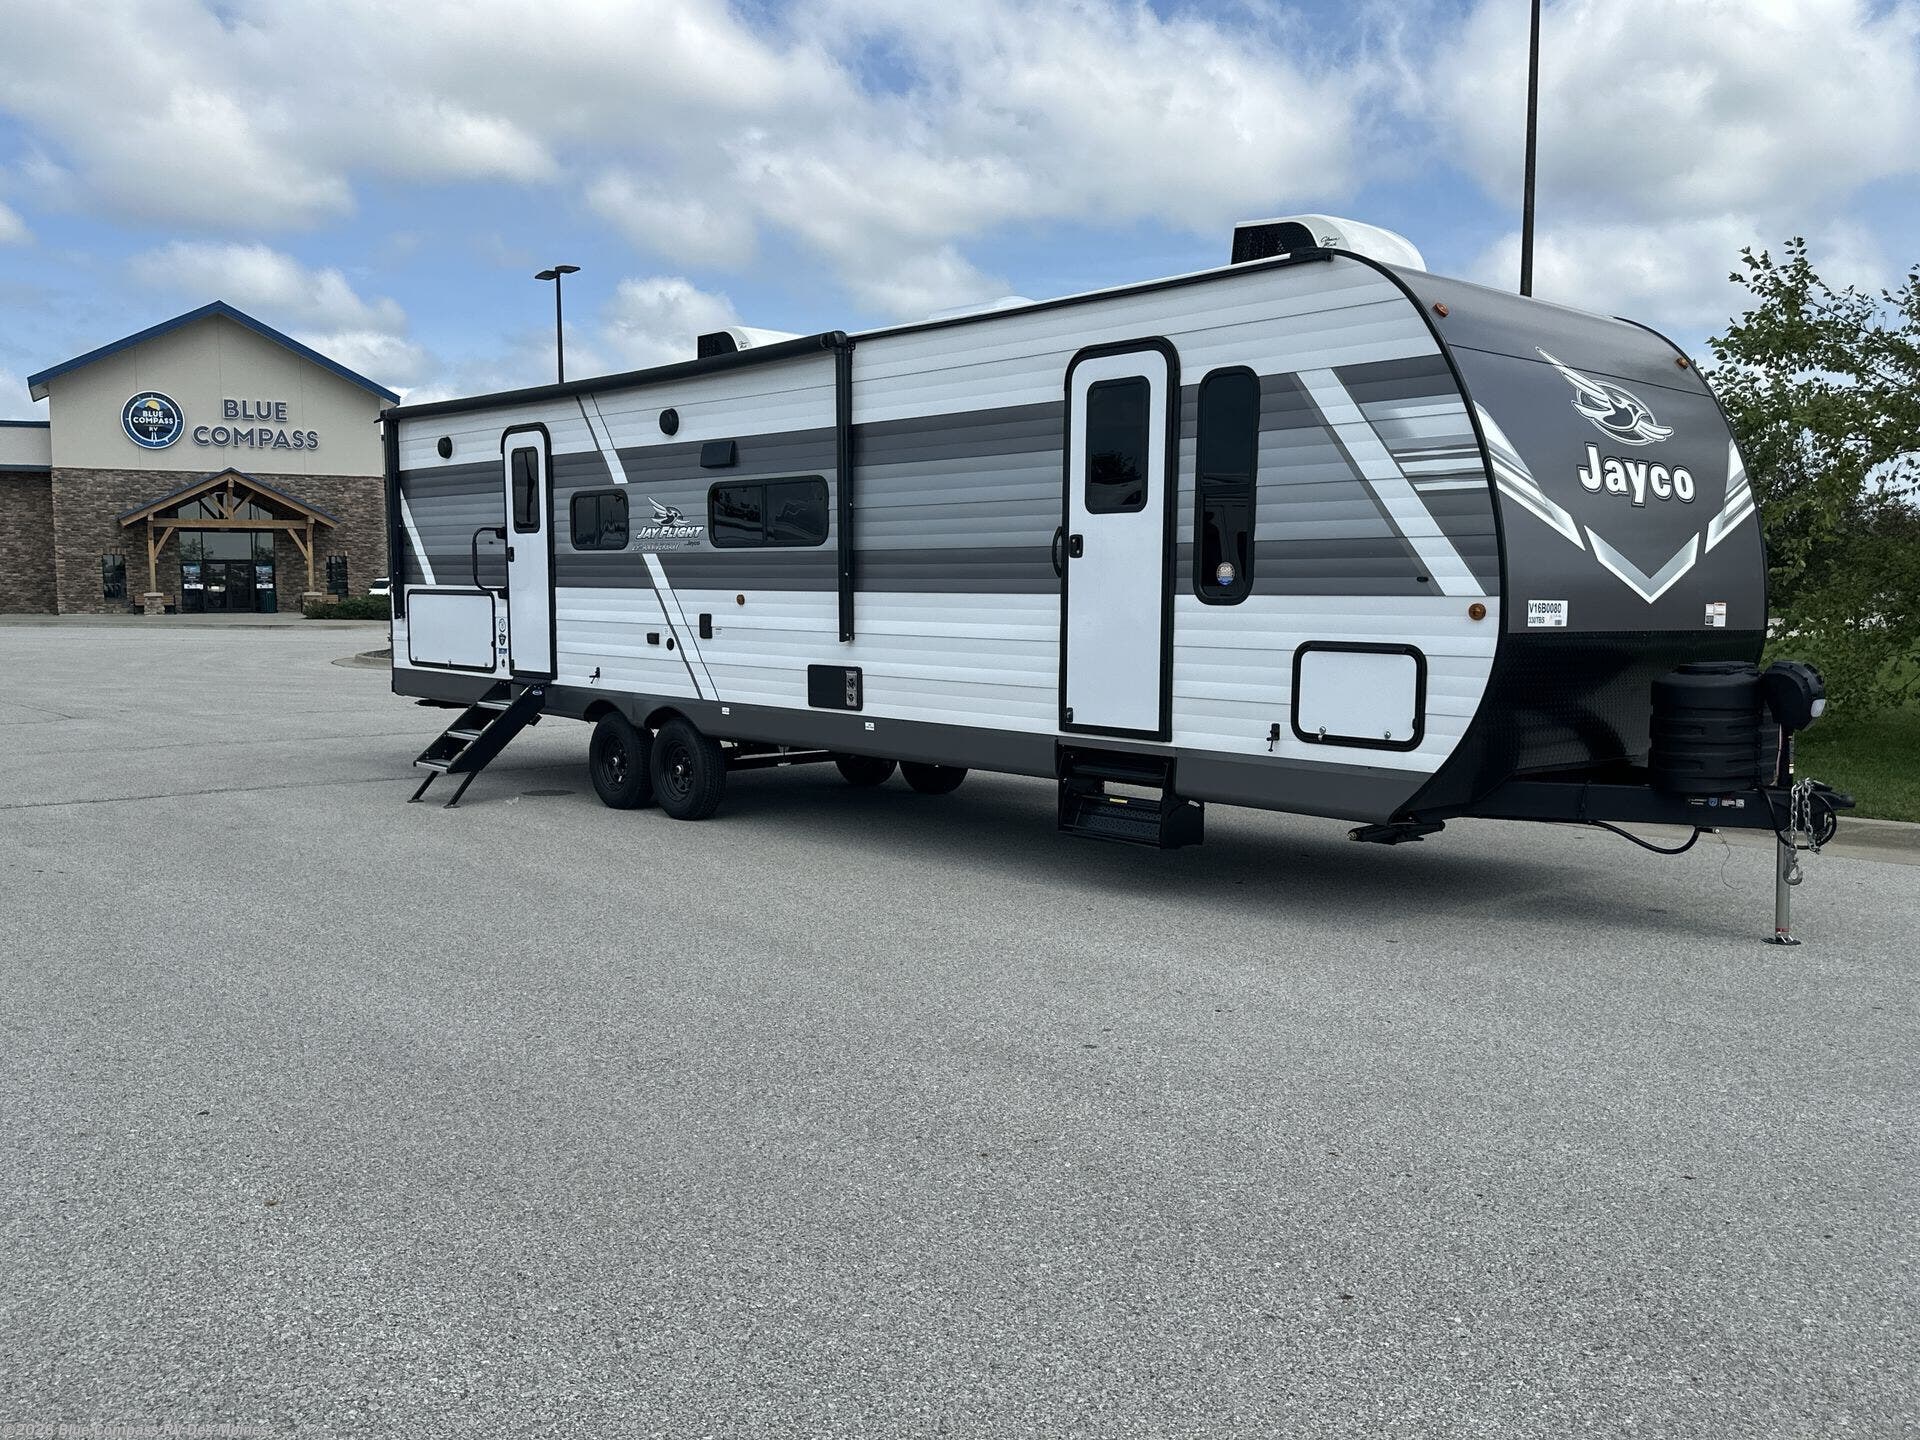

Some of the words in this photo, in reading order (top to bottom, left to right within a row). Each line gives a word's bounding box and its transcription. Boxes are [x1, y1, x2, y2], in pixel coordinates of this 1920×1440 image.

[142, 410, 164, 418] BLUE
[223, 398, 288, 422] BLUE
[133, 416, 174, 425] COMPASS
[192, 425, 320, 450] COMPASS
[1577, 442, 1696, 507] Jayco
[636, 526, 660, 539] JAY
[659, 526, 704, 539] FLIGHT
[1528, 602, 1562, 613] V16B0080
